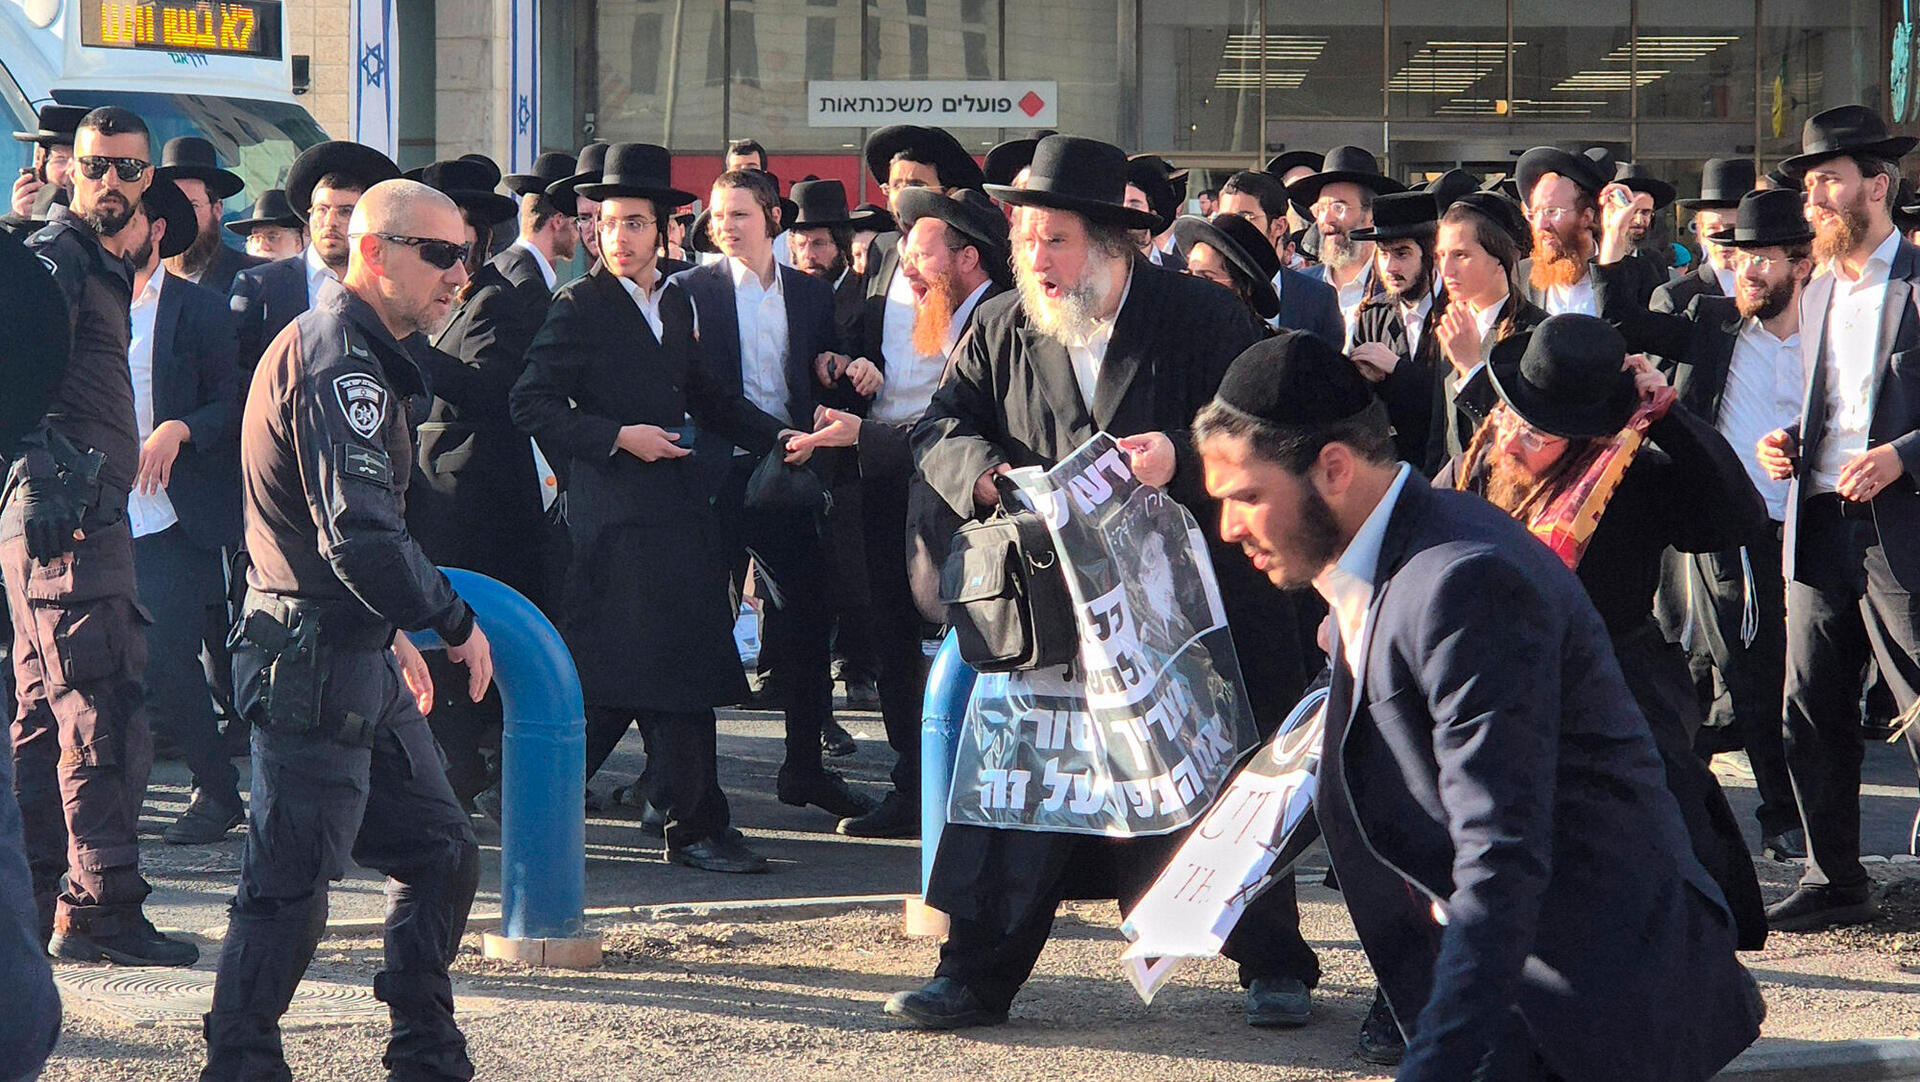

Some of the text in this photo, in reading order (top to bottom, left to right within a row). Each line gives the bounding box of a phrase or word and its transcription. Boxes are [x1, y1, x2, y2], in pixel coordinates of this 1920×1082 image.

[221, 3, 254, 49] לא
[819, 95, 1012, 113] פועלים משכנתאות
[979, 769, 1031, 810] זה
[1042, 757, 1106, 814] על
